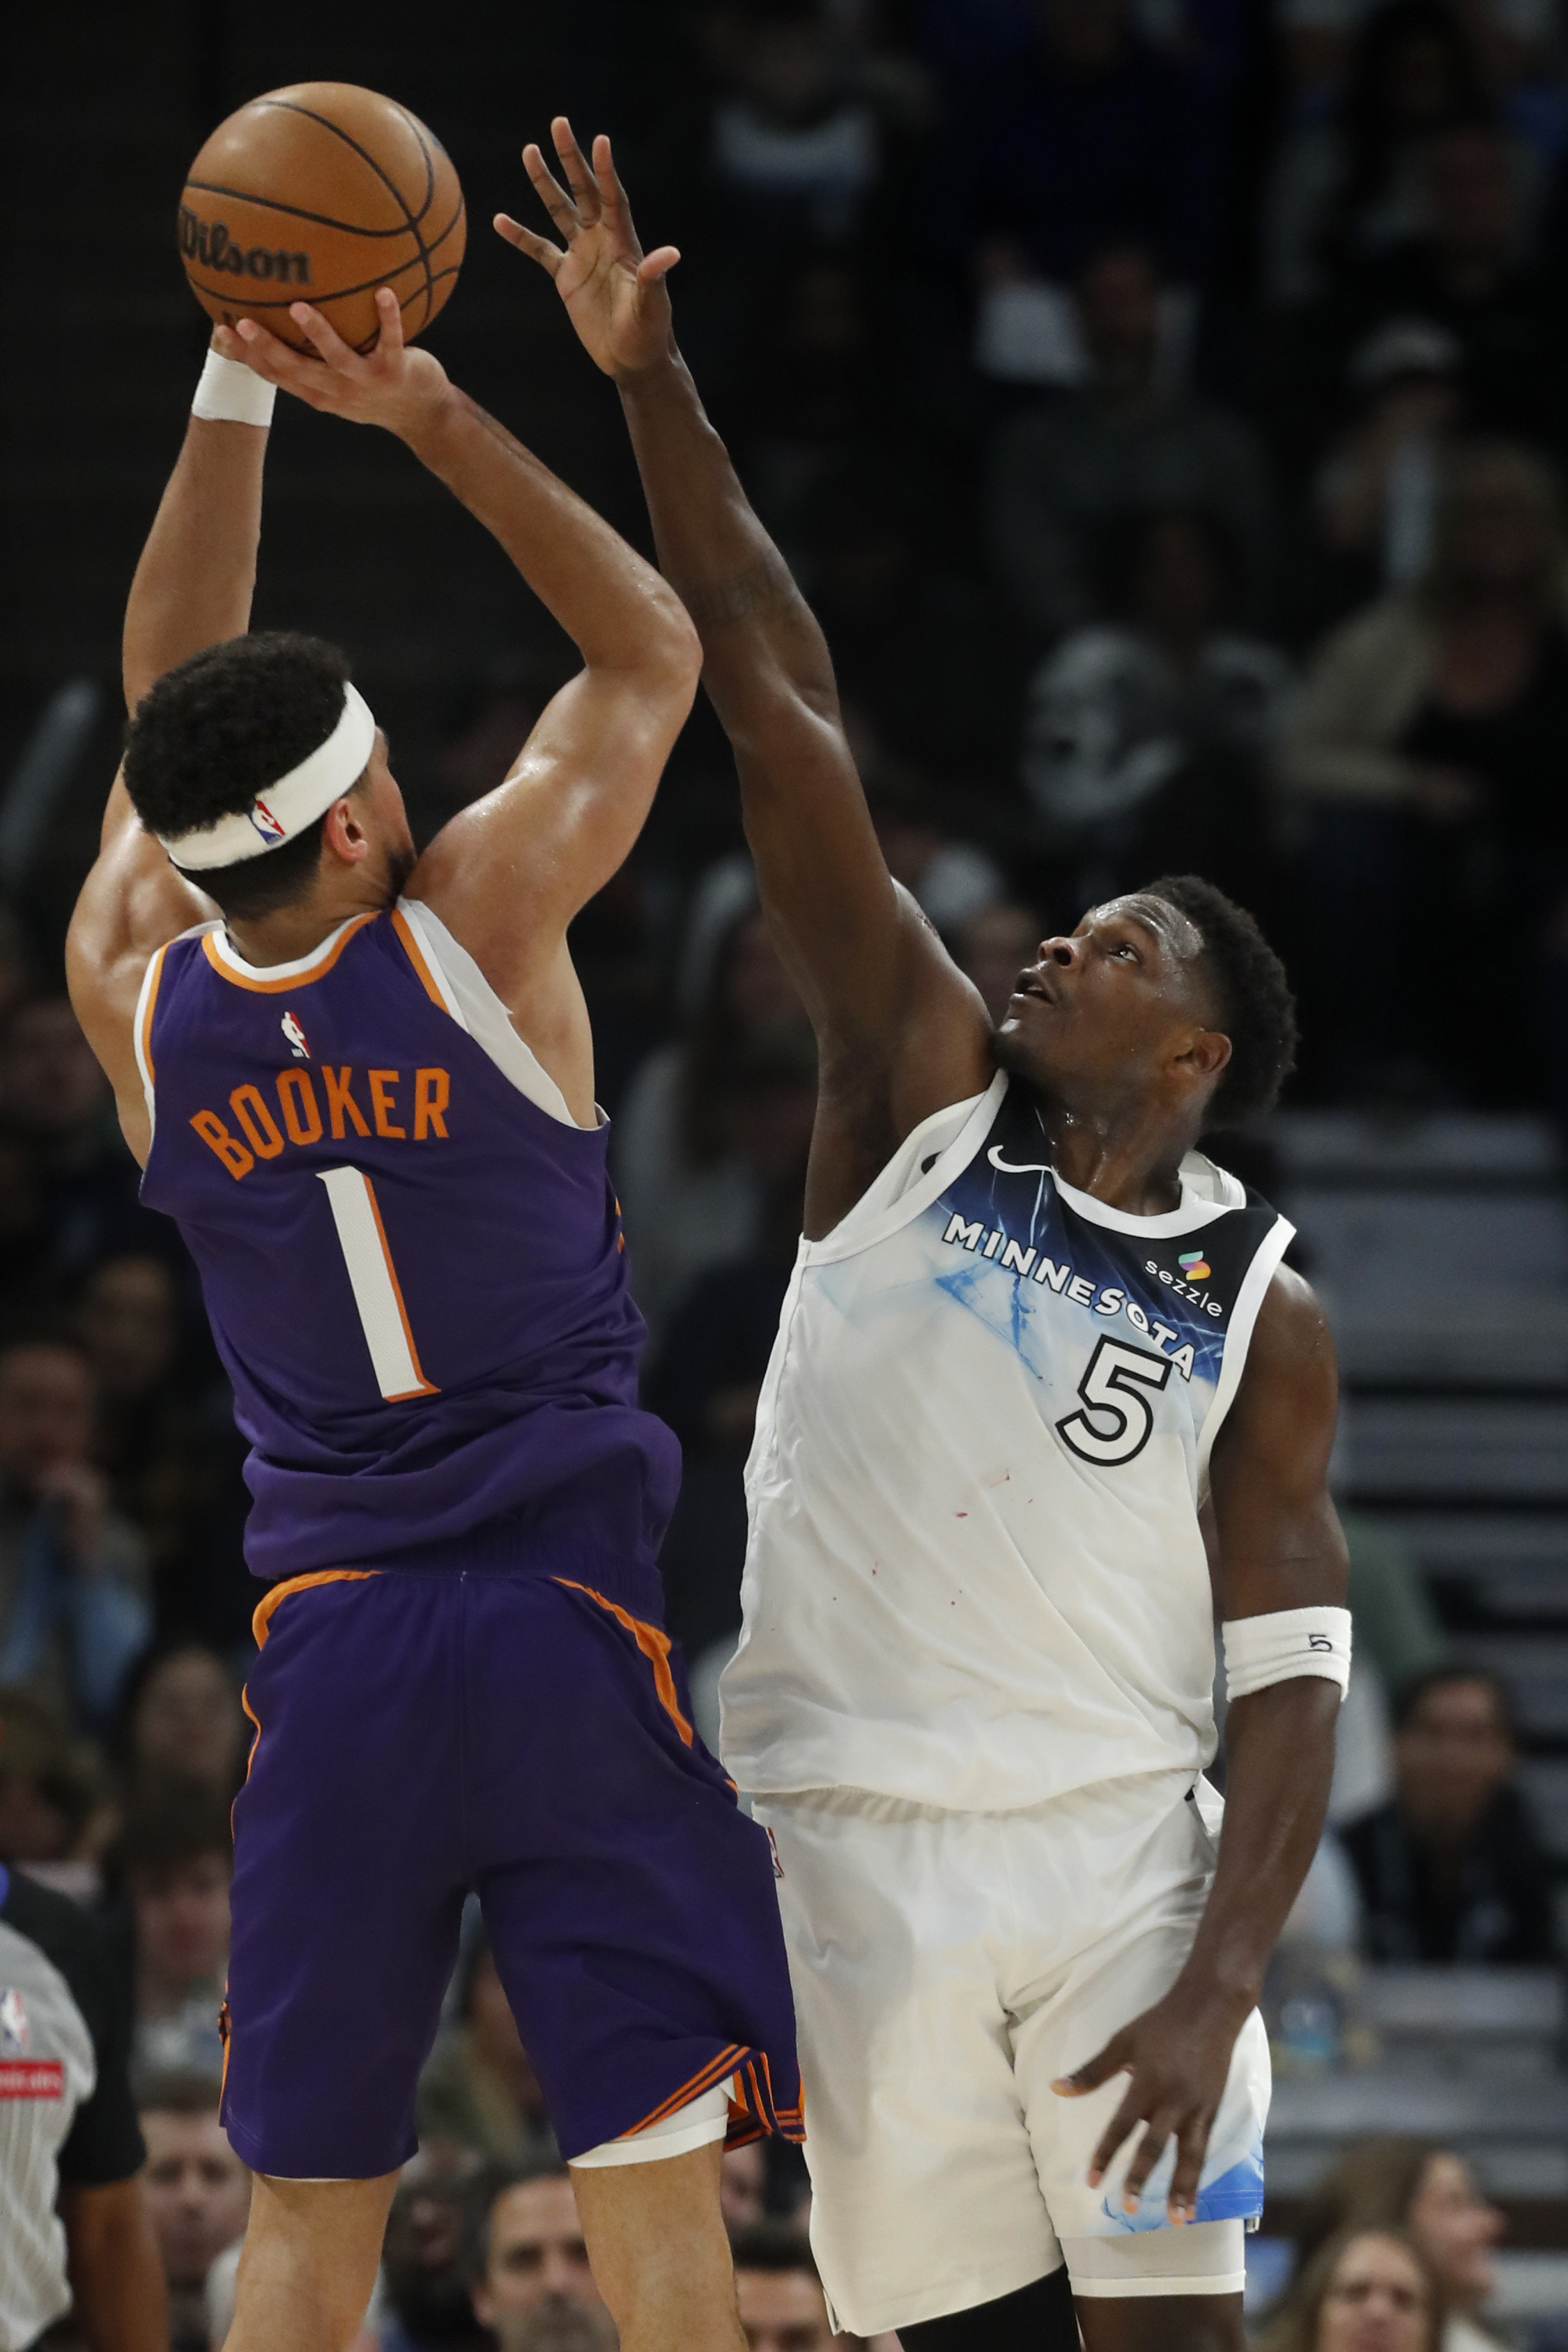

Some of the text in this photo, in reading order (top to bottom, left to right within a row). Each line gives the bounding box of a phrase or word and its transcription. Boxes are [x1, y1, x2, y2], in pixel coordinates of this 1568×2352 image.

[189, 1065, 450, 1181] BOOKER
[315, 1165, 442, 1404] 1
[941, 1211, 1195, 1383] MINNESOTA
[1144, 1260, 1223, 1317] sezzle
[1055, 1333, 1174, 1466] 5
[1308, 1634, 1332, 1652] 5
